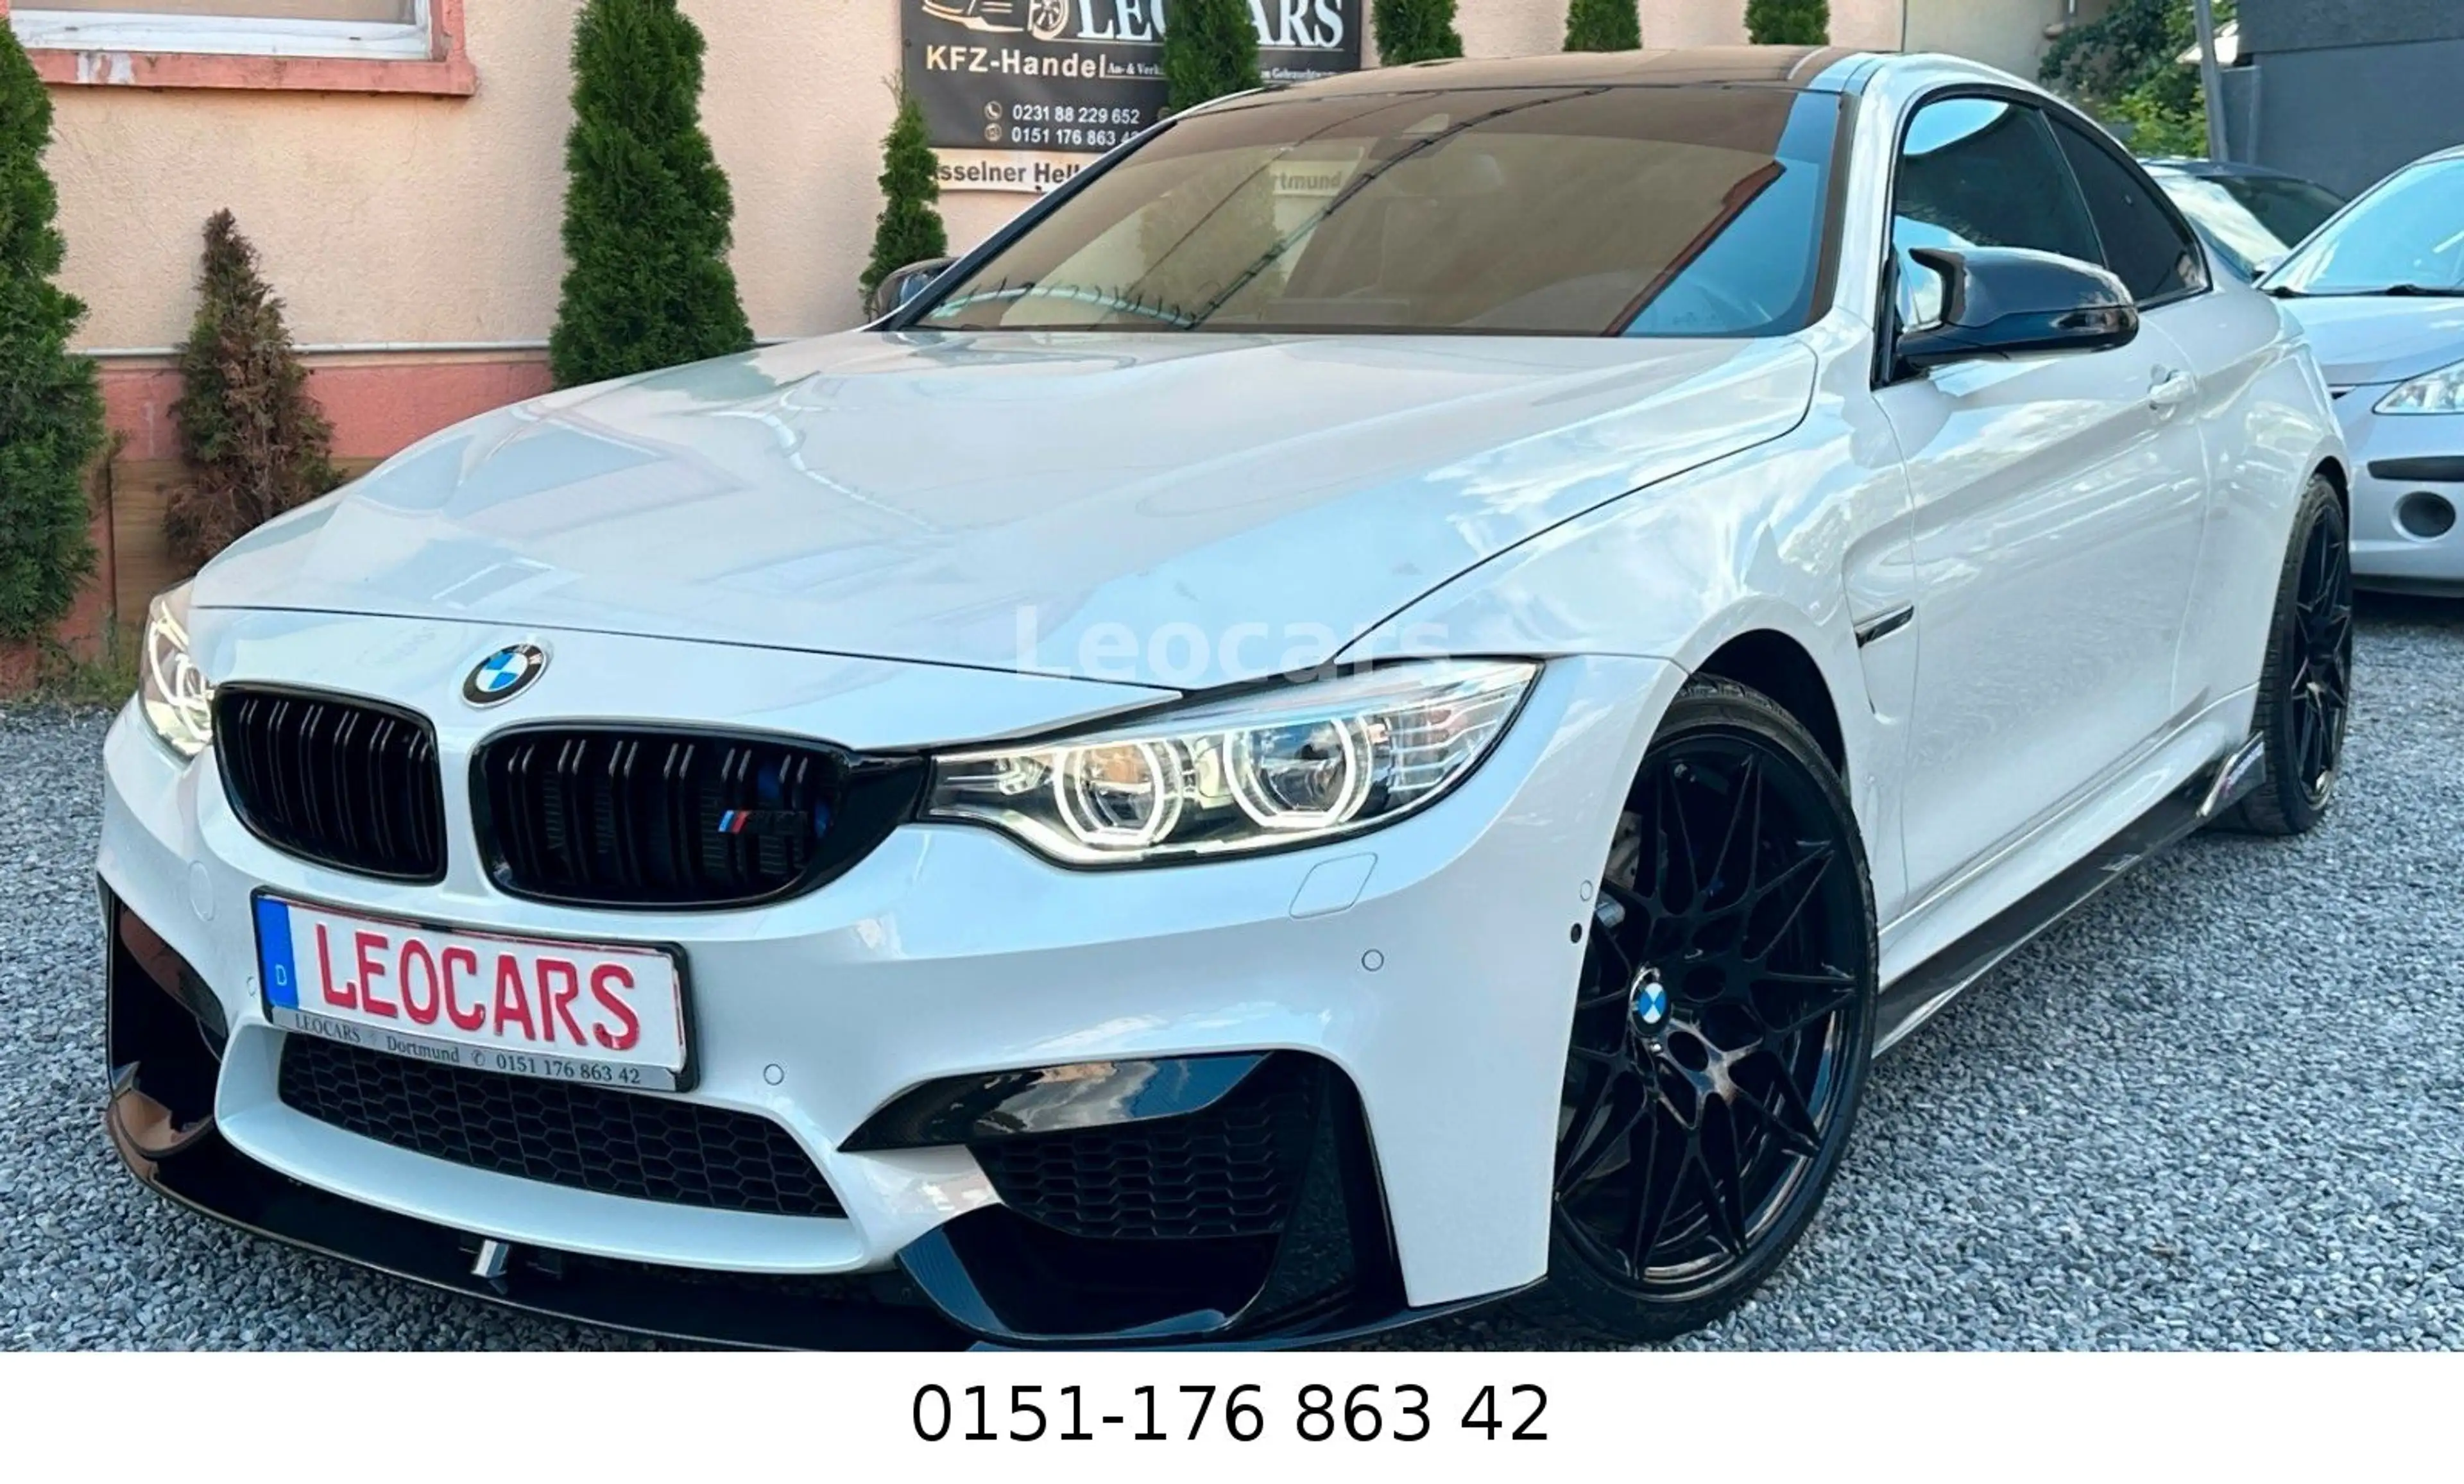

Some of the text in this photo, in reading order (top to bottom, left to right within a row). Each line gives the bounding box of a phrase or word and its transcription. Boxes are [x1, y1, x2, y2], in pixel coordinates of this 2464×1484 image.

[1077, 0, 1344, 47] LEARS
[926, 45, 1107, 78] KFZ-Handel
[1013, 104, 1140, 124] 0231 88 229 652
[1011, 127, 1049, 143] 0151
[1056, 128, 1082, 145] 176
[1087, 130, 1115, 146] 863
[275, 964, 287, 986] D
[316, 923, 640, 1051] LEOCARS
[295, 1013, 641, 1084] LEOCARS Dortmund 0151 176 863 42
